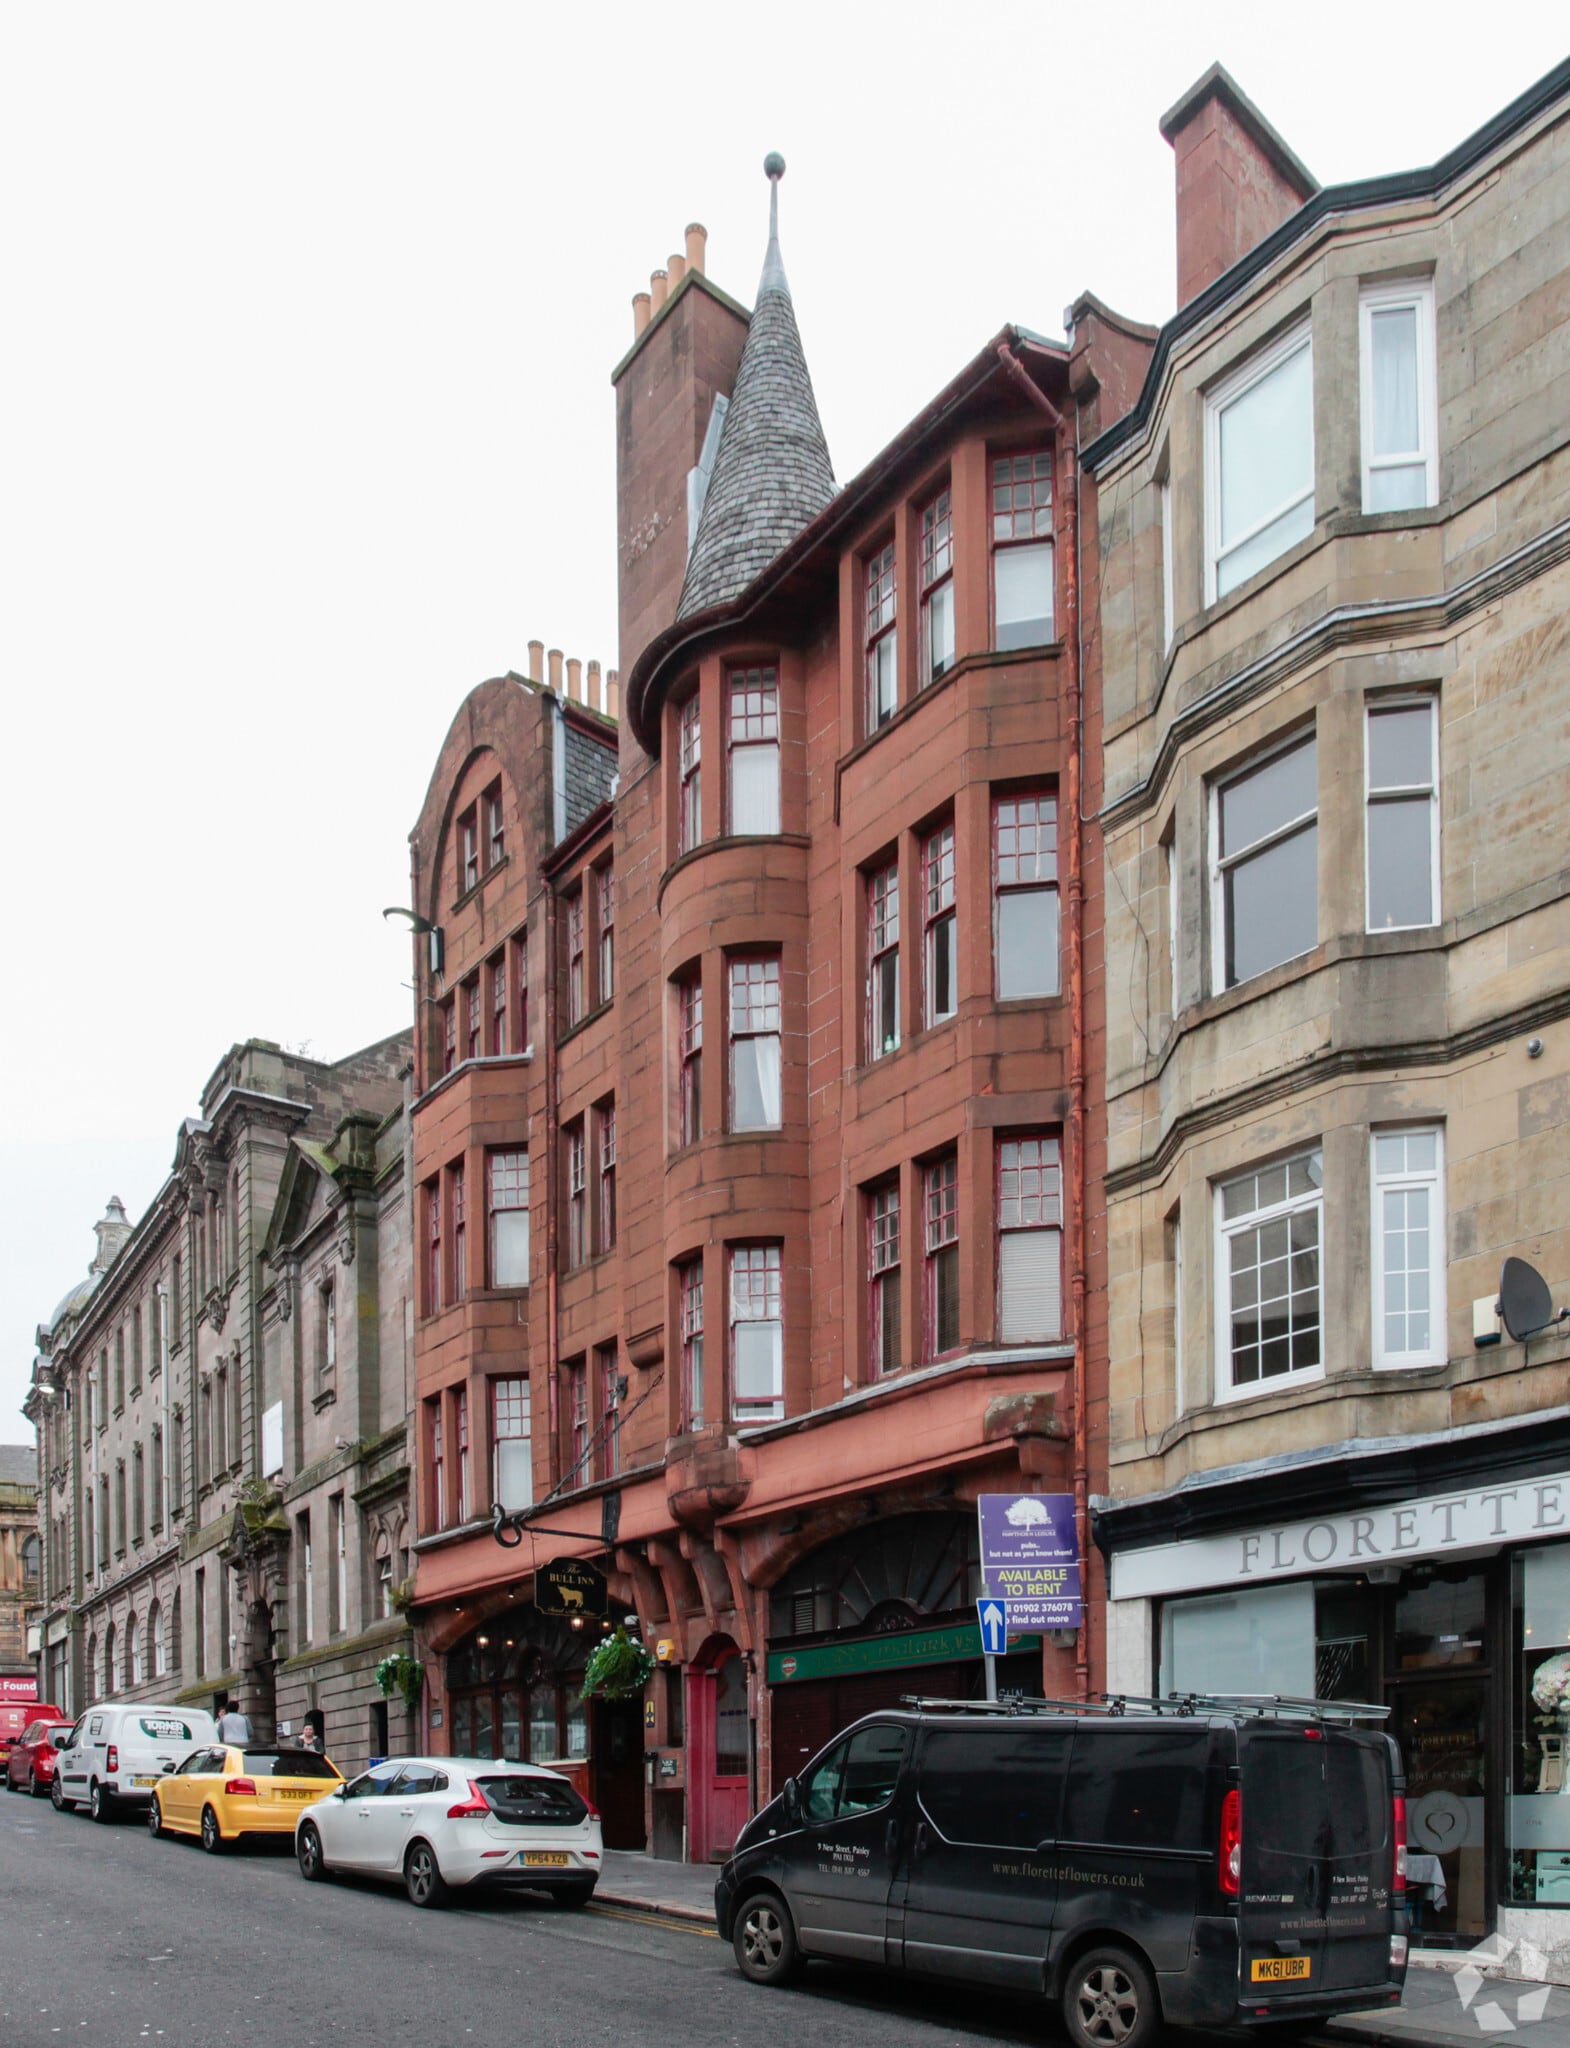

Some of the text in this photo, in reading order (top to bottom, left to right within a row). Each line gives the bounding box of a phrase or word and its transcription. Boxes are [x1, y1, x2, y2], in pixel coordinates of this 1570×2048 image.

[1239, 1483, 1565, 1574] FLORETTE
[549, 1573, 595, 1585] BULL INN
[998, 1568, 1068, 1582] AVAILABLE
[1004, 1582, 1062, 1596] TO RENT
[1013, 1603, 1040, 1613] 01902
[1041, 1602, 1073, 1613] 376078
[1012, 1615, 1029, 1624] find
[1031, 1615, 1046, 1624] out
[1047, 1615, 1070, 1623] more
[3, 1681, 37, 1691] Found
[822, 1843, 834, 1852] New
[852, 1846, 870, 1858] Paisley
[525, 1853, 549, 1864] YP64
[992, 1862, 1145, 1888] www.floretteflowers.co.uk
[1245, 1894, 1281, 1903] RENAULT
[1258, 1960, 1305, 1978] MK61 UBR
